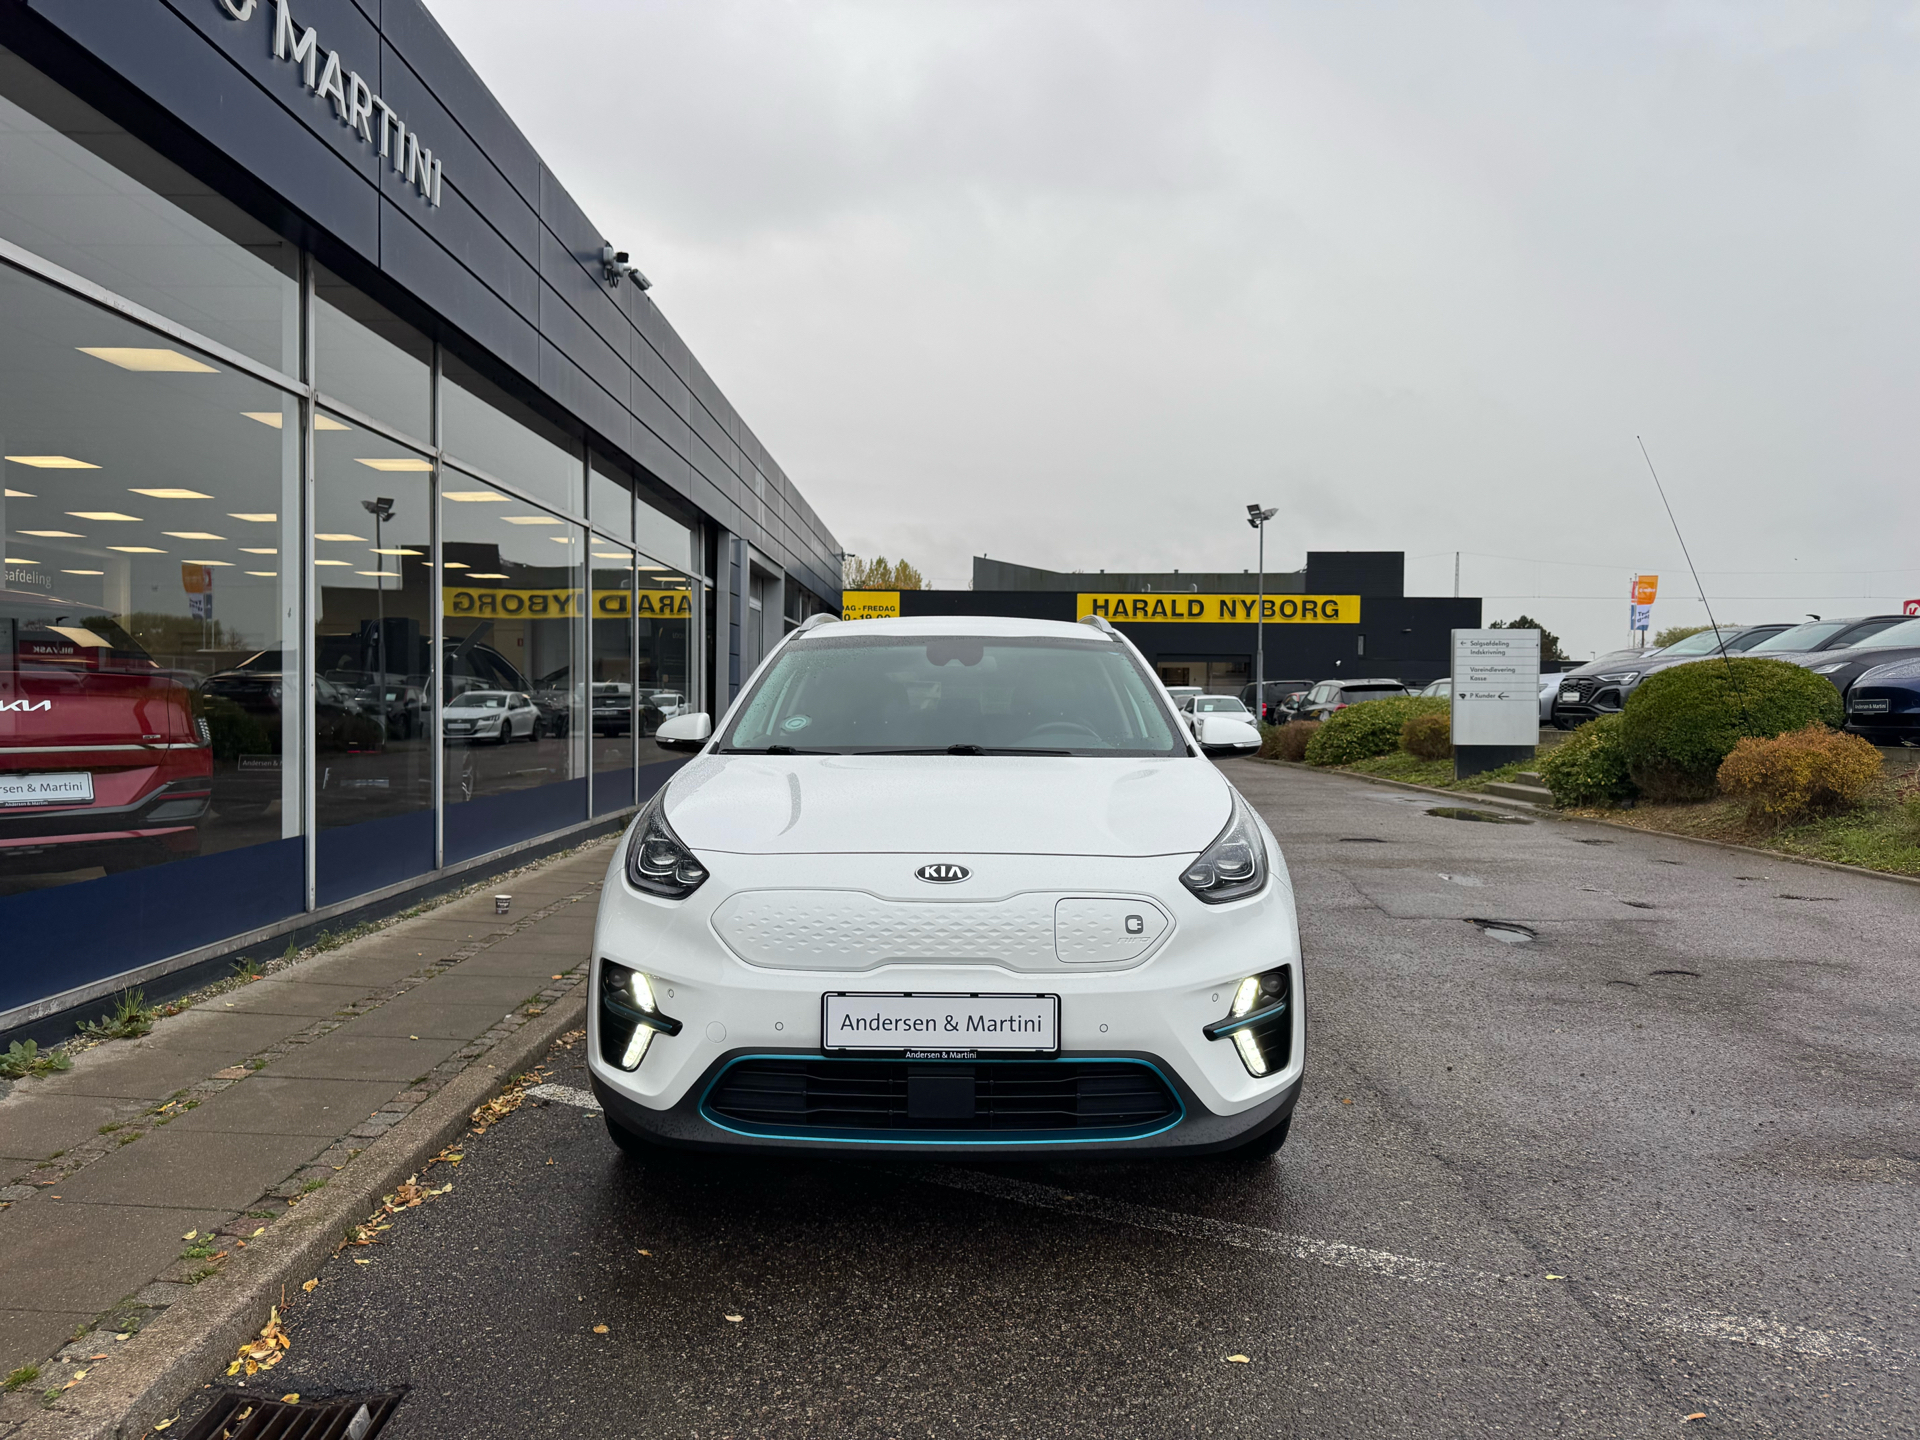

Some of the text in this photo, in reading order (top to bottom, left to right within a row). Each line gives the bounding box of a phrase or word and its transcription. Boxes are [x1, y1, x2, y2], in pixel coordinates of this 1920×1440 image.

[272, 0, 442, 208] MARTINI
[1092, 598, 1339, 619] HARALD NYBORG
[1470, 640, 1510, 648] Salgsafdeling
[27, 784, 36, 792] &
[40, 782, 83, 792] Martini
[924, 865, 963, 878] KIA
[840, 1013, 1042, 1032] Andersen & Martini
